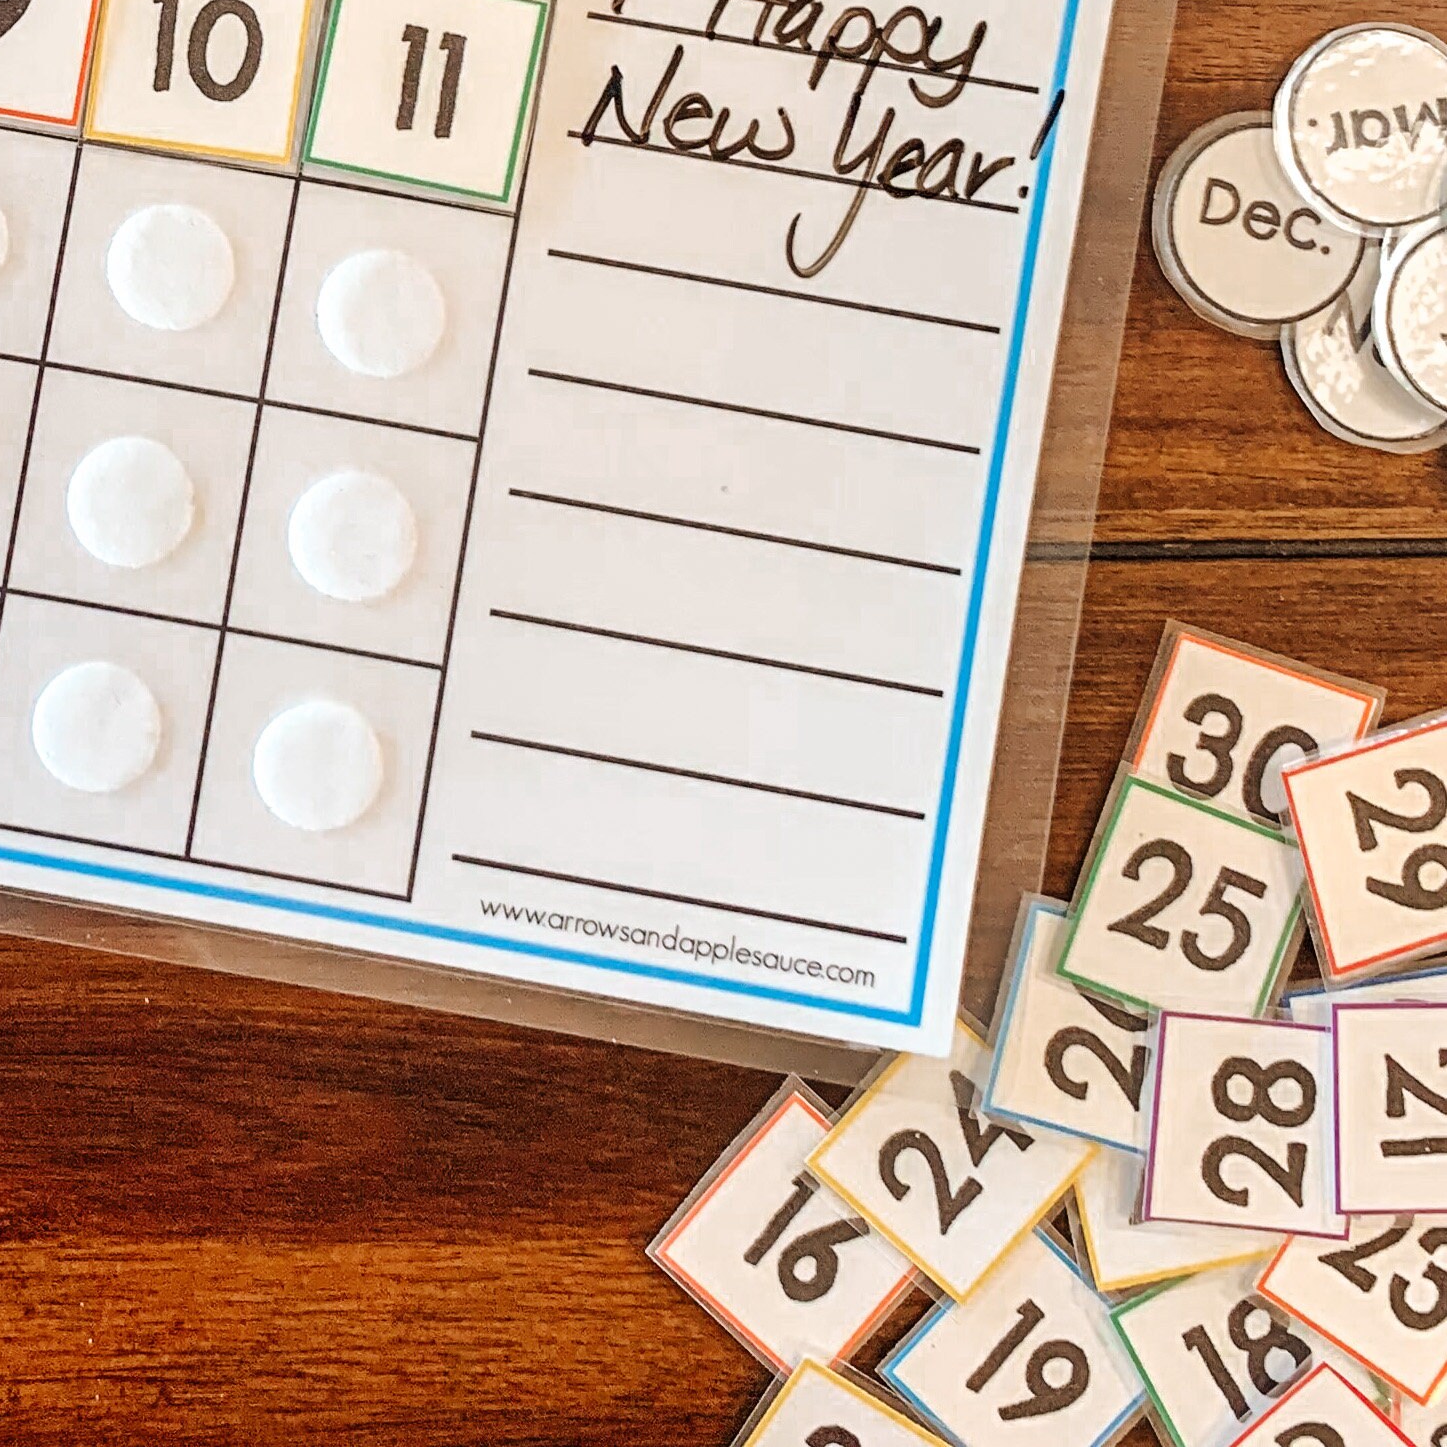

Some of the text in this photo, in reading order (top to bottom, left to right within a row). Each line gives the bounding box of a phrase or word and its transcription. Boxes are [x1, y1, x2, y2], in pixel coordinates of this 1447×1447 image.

[396, 24, 467, 139] 11
[581, 45, 795, 160] New
[1199, 177, 1331, 256] Dec.
[1166, 693, 1319, 829] 30
[1107, 837, 1268, 972] 25
[1345, 767, 1447, 911] 29
[479, 897, 876, 988] www.arrowsandapplesauce.com
[878, 1068, 1036, 1236] 24
[1201, 1056, 1317, 1209] 28
[743, 1170, 871, 1303] 16
[965, 1298, 1090, 1421] 19
[1181, 1293, 1314, 1424] 18
